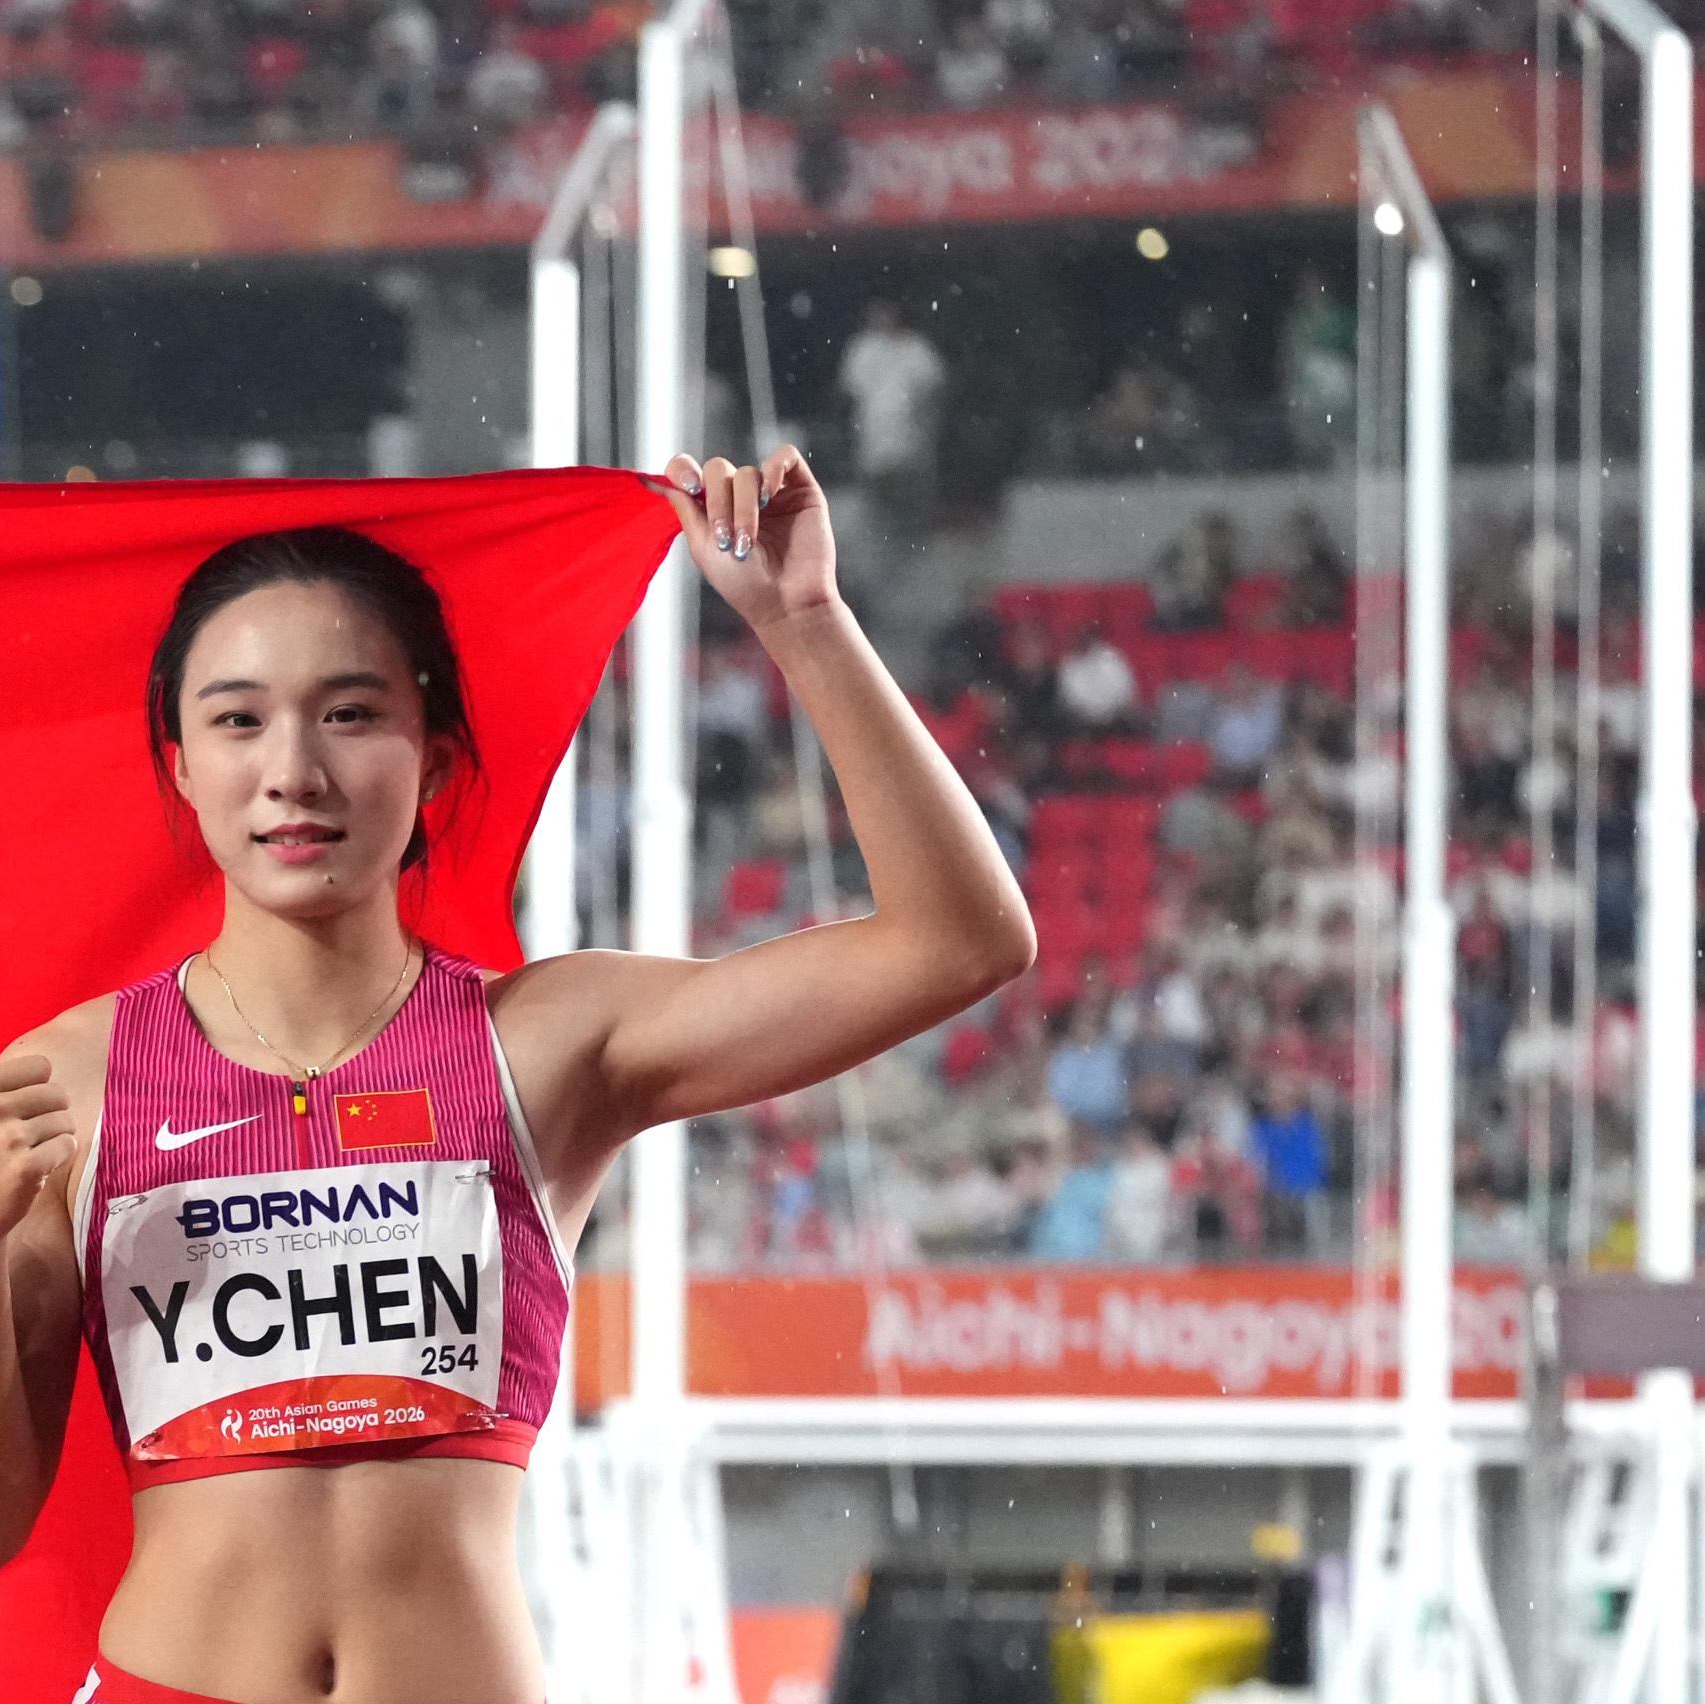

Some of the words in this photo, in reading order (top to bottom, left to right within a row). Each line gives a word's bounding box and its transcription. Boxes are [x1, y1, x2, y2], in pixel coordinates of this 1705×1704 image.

[175, 1180, 420, 1239] BORNAN
[186, 1237, 268, 1263] SPORTS
[277, 1222, 421, 1256] TECHNOLOGY
[129, 1253, 478, 1365] Y.CHEN
[420, 1343, 479, 1378] 254
[248, 1407, 281, 1422] 20th
[283, 1402, 323, 1419] Asian
[326, 1397, 378, 1414] Games
[250, 1413, 380, 1440] Aichi-Nagoya
[383, 1405, 426, 1426] 2026
